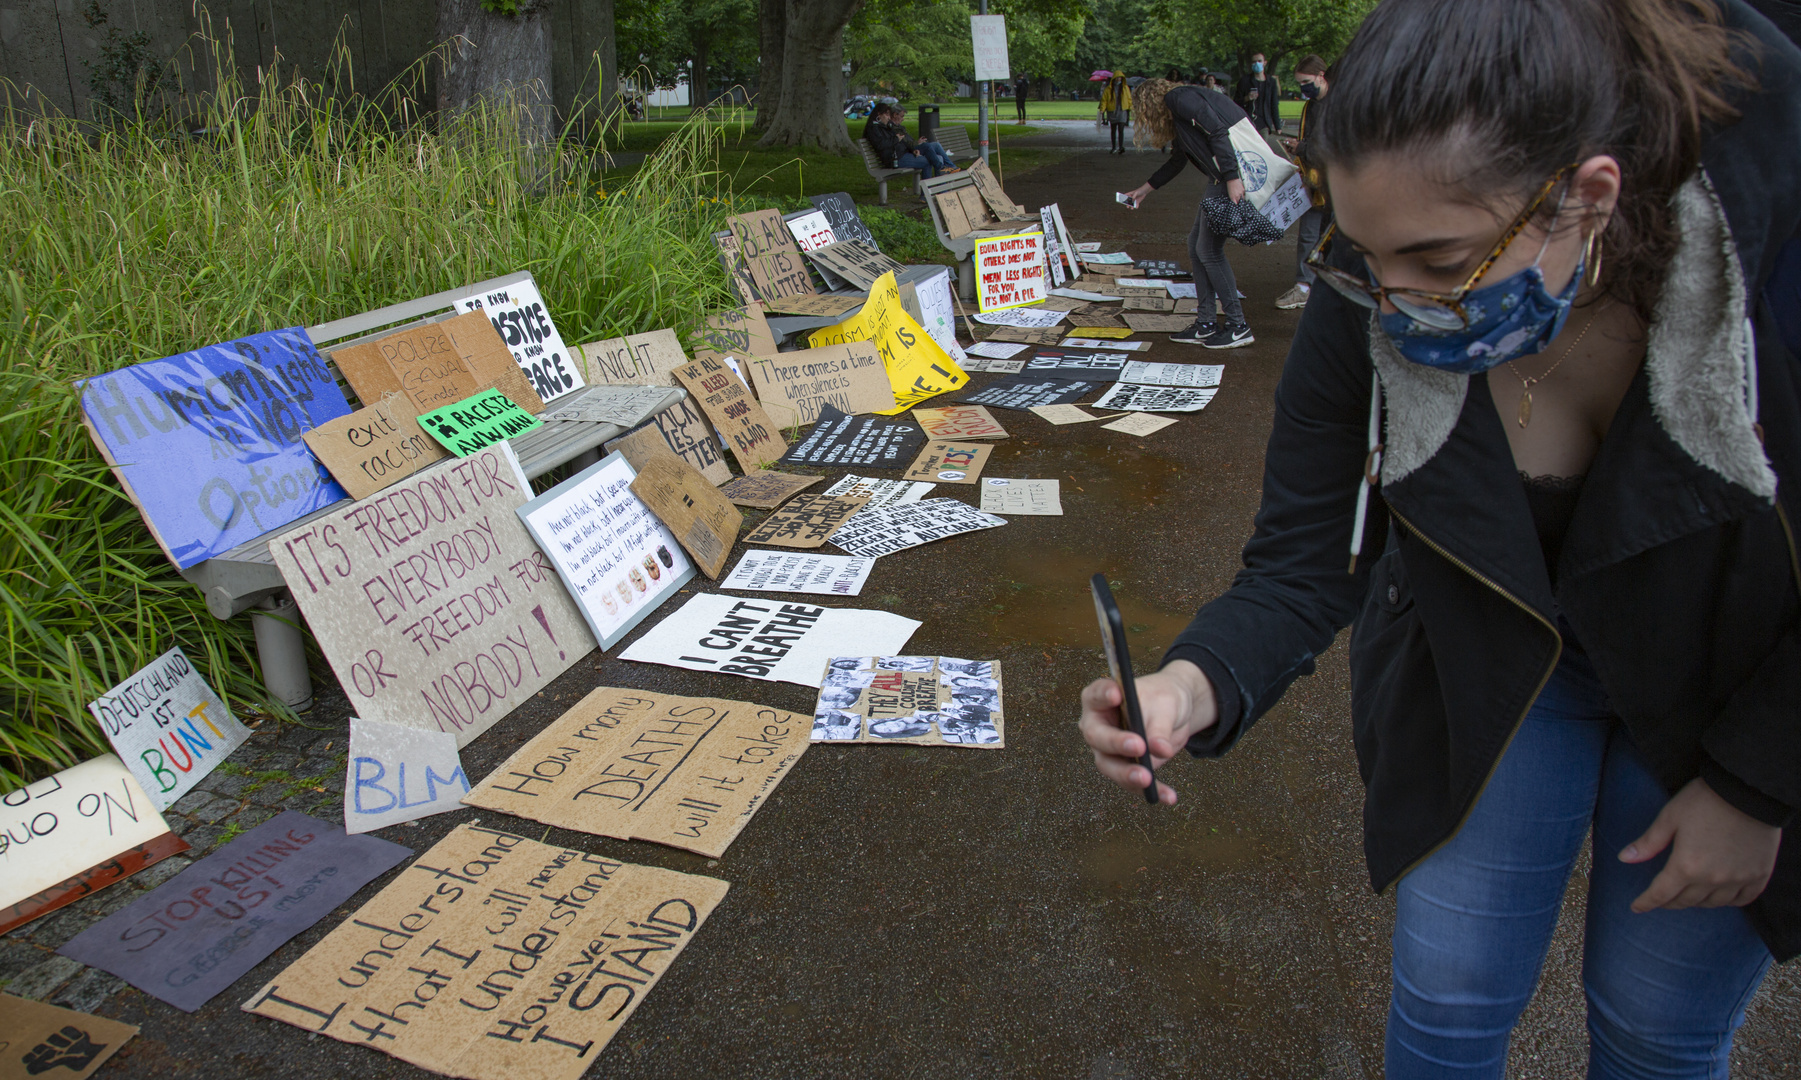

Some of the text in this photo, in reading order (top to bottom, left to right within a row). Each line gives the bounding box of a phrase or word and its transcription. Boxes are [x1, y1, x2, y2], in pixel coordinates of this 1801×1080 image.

[734, 216, 793, 258] BLACK
[798, 229, 837, 252] BLEED
[831, 240, 880, 266] HAVE
[980, 238, 1037, 255] EQUAL RIGHTS FOR
[760, 250, 792, 280] LIVES
[983, 266, 1042, 284] MEAN LESS RIGHTS
[984, 252, 1035, 267] OTHERS DOES NOT
[487, 291, 510, 305] KNOW
[761, 271, 812, 303] MATTER
[985, 296, 997, 307] IT'S
[1000, 294, 1011, 304] NOT
[1015, 291, 1020, 302] A
[988, 284, 999, 294] FOR
[868, 316, 876, 331] IS
[874, 295, 885, 316] NOT
[886, 286, 899, 301] AN
[382, 333, 460, 369] POLIZEI
[524, 344, 544, 359] KNOW
[596, 343, 656, 383] NICHT
[682, 357, 723, 380] WE ALL
[754, 359, 800, 384] There
[802, 360, 840, 377] comes
[841, 359, 848, 370] a
[847, 347, 876, 369] time
[403, 355, 478, 391] GEWALT
[701, 373, 730, 393] BLEED
[784, 374, 850, 400] when silence is
[88, 366, 259, 446] Human
[450, 395, 518, 429] RACIST?
[706, 384, 746, 407] THE SAME
[724, 399, 751, 420] SHADE
[797, 391, 856, 423] BETRAYAL
[250, 387, 315, 447] NOT
[347, 408, 396, 448] exit
[741, 416, 750, 426] OF
[936, 407, 1003, 436] RACISM
[359, 433, 433, 482] racism
[456, 426, 505, 456] AWW
[734, 423, 770, 456] BLOOD
[941, 447, 979, 471] RISE
[284, 452, 516, 593] IT'S FREEDOM FOR
[562, 506, 576, 527] not
[589, 490, 605, 507] but
[608, 484, 619, 497] see
[887, 509, 917, 519] KEINE
[572, 530, 583, 545] not
[600, 511, 612, 527] but
[580, 550, 591, 565] not
[601, 531, 613, 546] but
[616, 521, 632, 536] mourn
[631, 511, 641, 526] with
[830, 527, 872, 544] MENSCH
[887, 513, 928, 527] MENSCH
[839, 532, 886, 551] ZEIGEN
[587, 570, 599, 586] not
[612, 547, 626, 562] but
[630, 531, 644, 550] fight
[644, 524, 655, 537] with
[855, 536, 916, 558] UNSERE
[362, 516, 502, 626] EVERYBODY
[351, 551, 556, 698] OR FREEDOM FOR
[679, 600, 771, 665] I CAN'T
[719, 604, 825, 677] BREATHE
[100, 653, 189, 736] DEUTSCHLAND
[868, 672, 902, 717] THEY ALL
[917, 677, 937, 712] BREATHE
[151, 699, 175, 728] IST
[141, 701, 224, 793] BUNT
[492, 697, 655, 796] How many
[572, 706, 716, 809] DEATHS
[354, 757, 471, 814] BLM
[674, 710, 802, 839] will it take?
[77, 778, 138, 836] No
[120, 829, 316, 952] STOP KILLING
[215, 875, 284, 920] US!
[256, 825, 525, 1031] I understand
[349, 849, 580, 1042] that I will never
[460, 852, 623, 1011] understand
[164, 915, 273, 988] GEORGE
[531, 898, 697, 1058] I STAND
